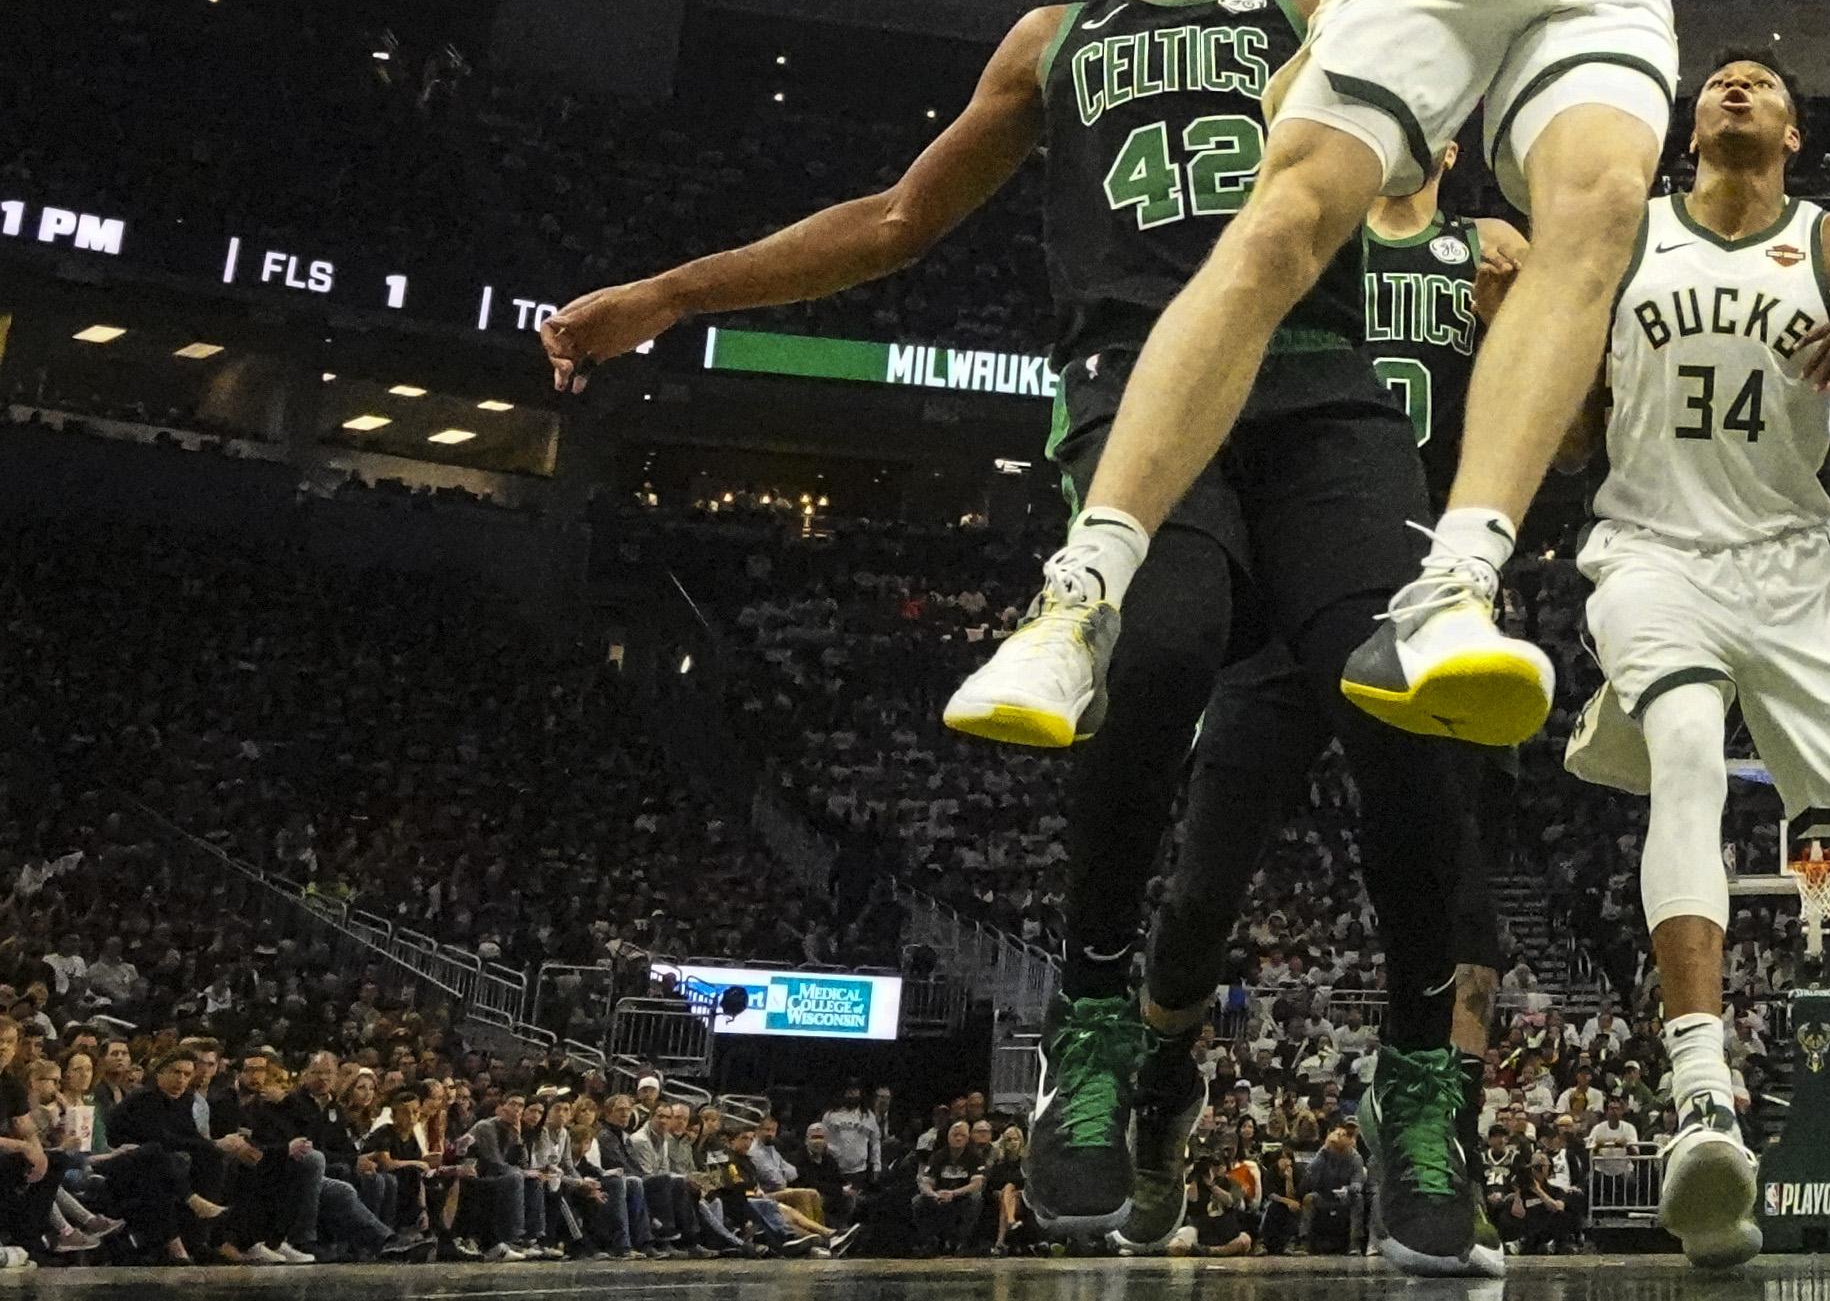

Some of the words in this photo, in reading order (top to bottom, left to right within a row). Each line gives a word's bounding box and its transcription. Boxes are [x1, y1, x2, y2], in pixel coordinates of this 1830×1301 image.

[1072, 25, 1269, 127] CELTICS
[1103, 114, 1266, 231] 42
[38, 207, 124, 256] PM
[261, 250, 334, 293] FLS
[385, 274, 407, 309] 1
[1634, 287, 1815, 360] BUCKS
[1675, 364, 1765, 442] 34
[787, 996, 852, 1013] COLLEGE
[788, 1011, 865, 1028] WISCONSIN
[800, 982, 863, 1001] MEDICAL
